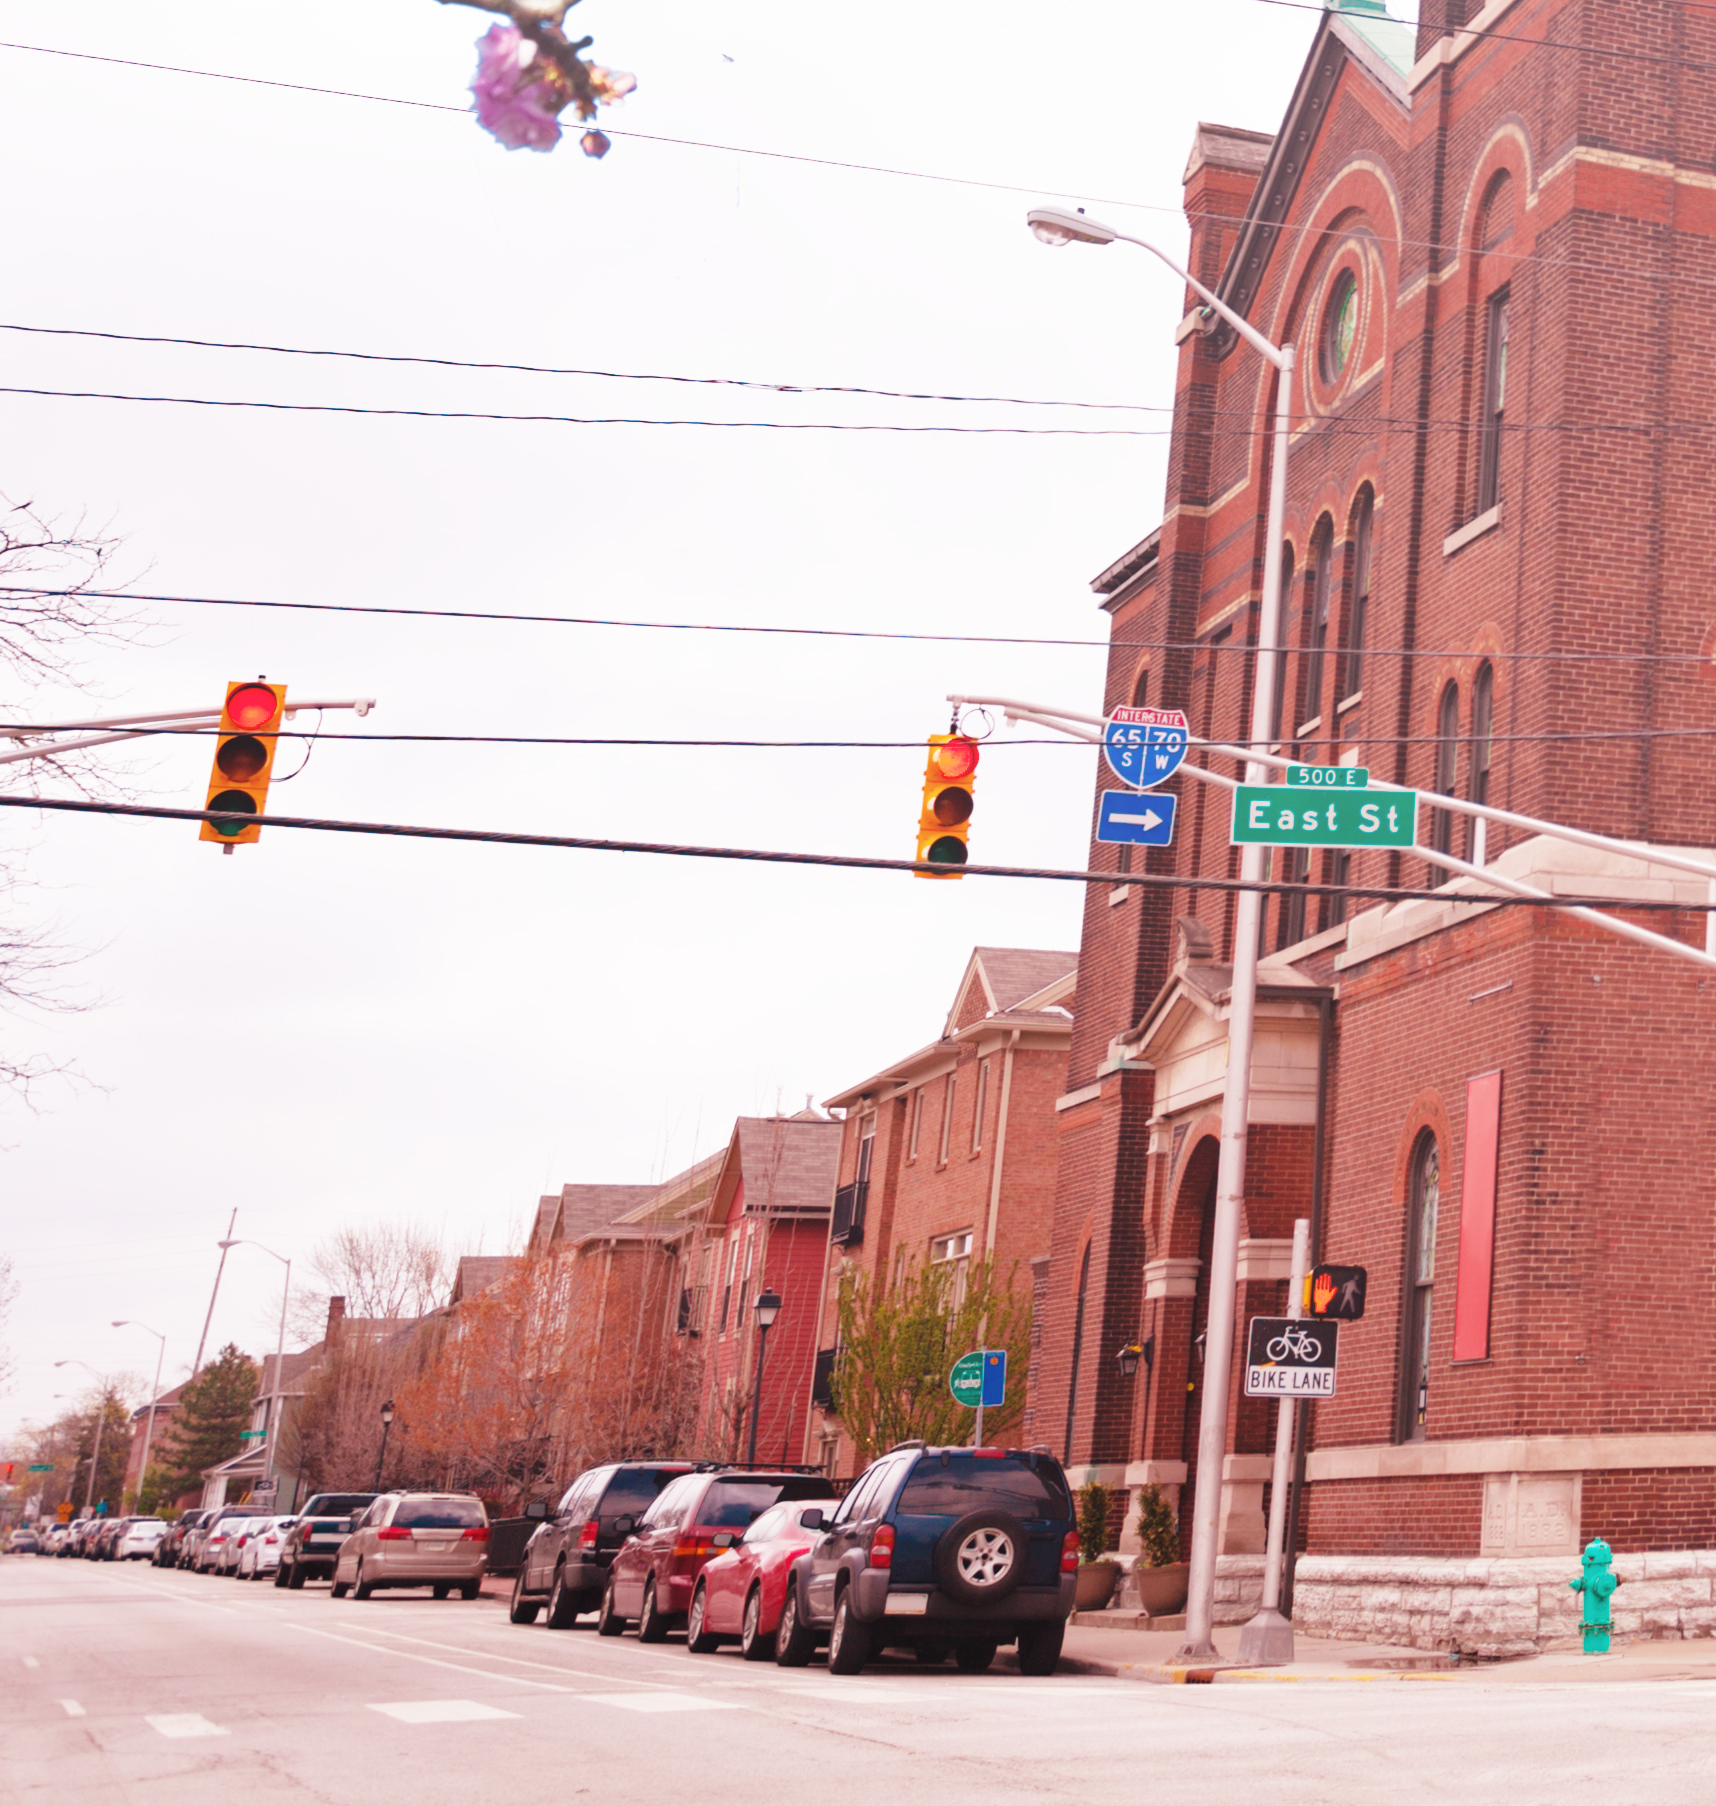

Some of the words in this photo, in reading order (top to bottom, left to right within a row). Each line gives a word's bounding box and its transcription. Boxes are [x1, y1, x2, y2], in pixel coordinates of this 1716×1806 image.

[1117, 710, 1181, 726] INTERSTATE
[1111, 728, 1142, 750] 65
[1153, 731, 1182, 753] 70
[1121, 751, 1133, 767] S
[1155, 754, 1169, 770] W
[1298, 767, 1337, 785] 500
[1346, 769, 1356, 785] E
[1248, 800, 1338, 831] East
[1358, 803, 1400, 833] St
[1250, 1370, 1287, 1389] BIKE
[1292, 1371, 1331, 1390] LANE
